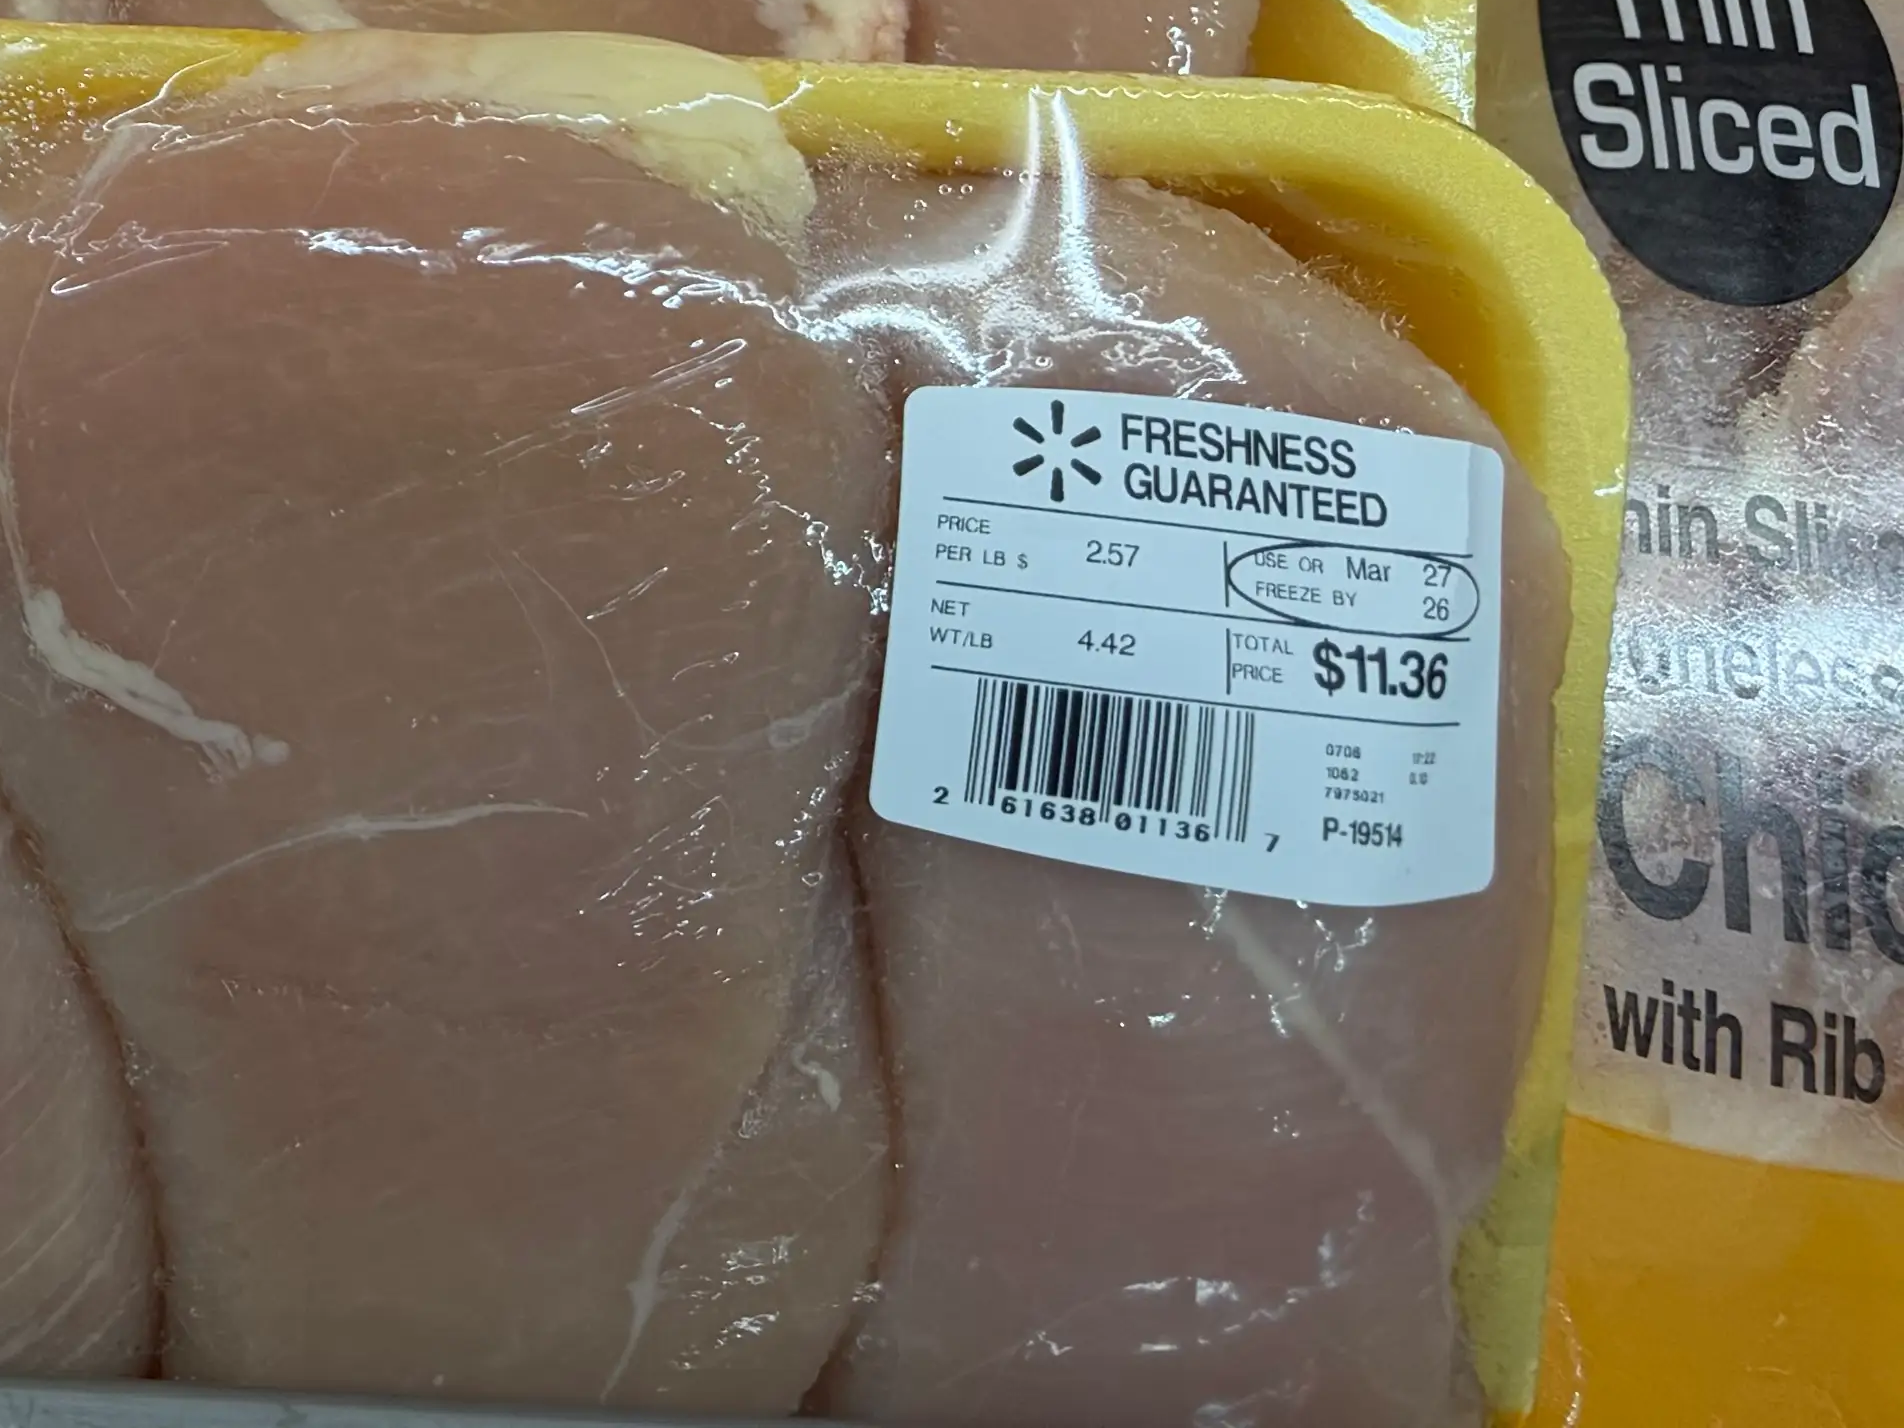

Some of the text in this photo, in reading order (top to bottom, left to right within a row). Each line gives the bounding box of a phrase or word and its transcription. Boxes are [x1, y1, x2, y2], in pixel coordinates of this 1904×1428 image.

[1573, 62, 1880, 189] Sliced
[1121, 412, 1356, 478] FRESHNESS
[1123, 464, 1387, 528] GUARANTEED
[1086, 539, 1140, 568] 2.57
[1254, 551, 1452, 588] USE OR Mar 27
[1423, 596, 1450, 622] 26
[1077, 629, 1137, 657] 4.42
[1313, 638, 1448, 700] $11.36
[932, 785, 1280, 853] 2 61638 01136 7
[1322, 816, 1403, 848] P-19514
[1604, 978, 1885, 1104] with Rib
